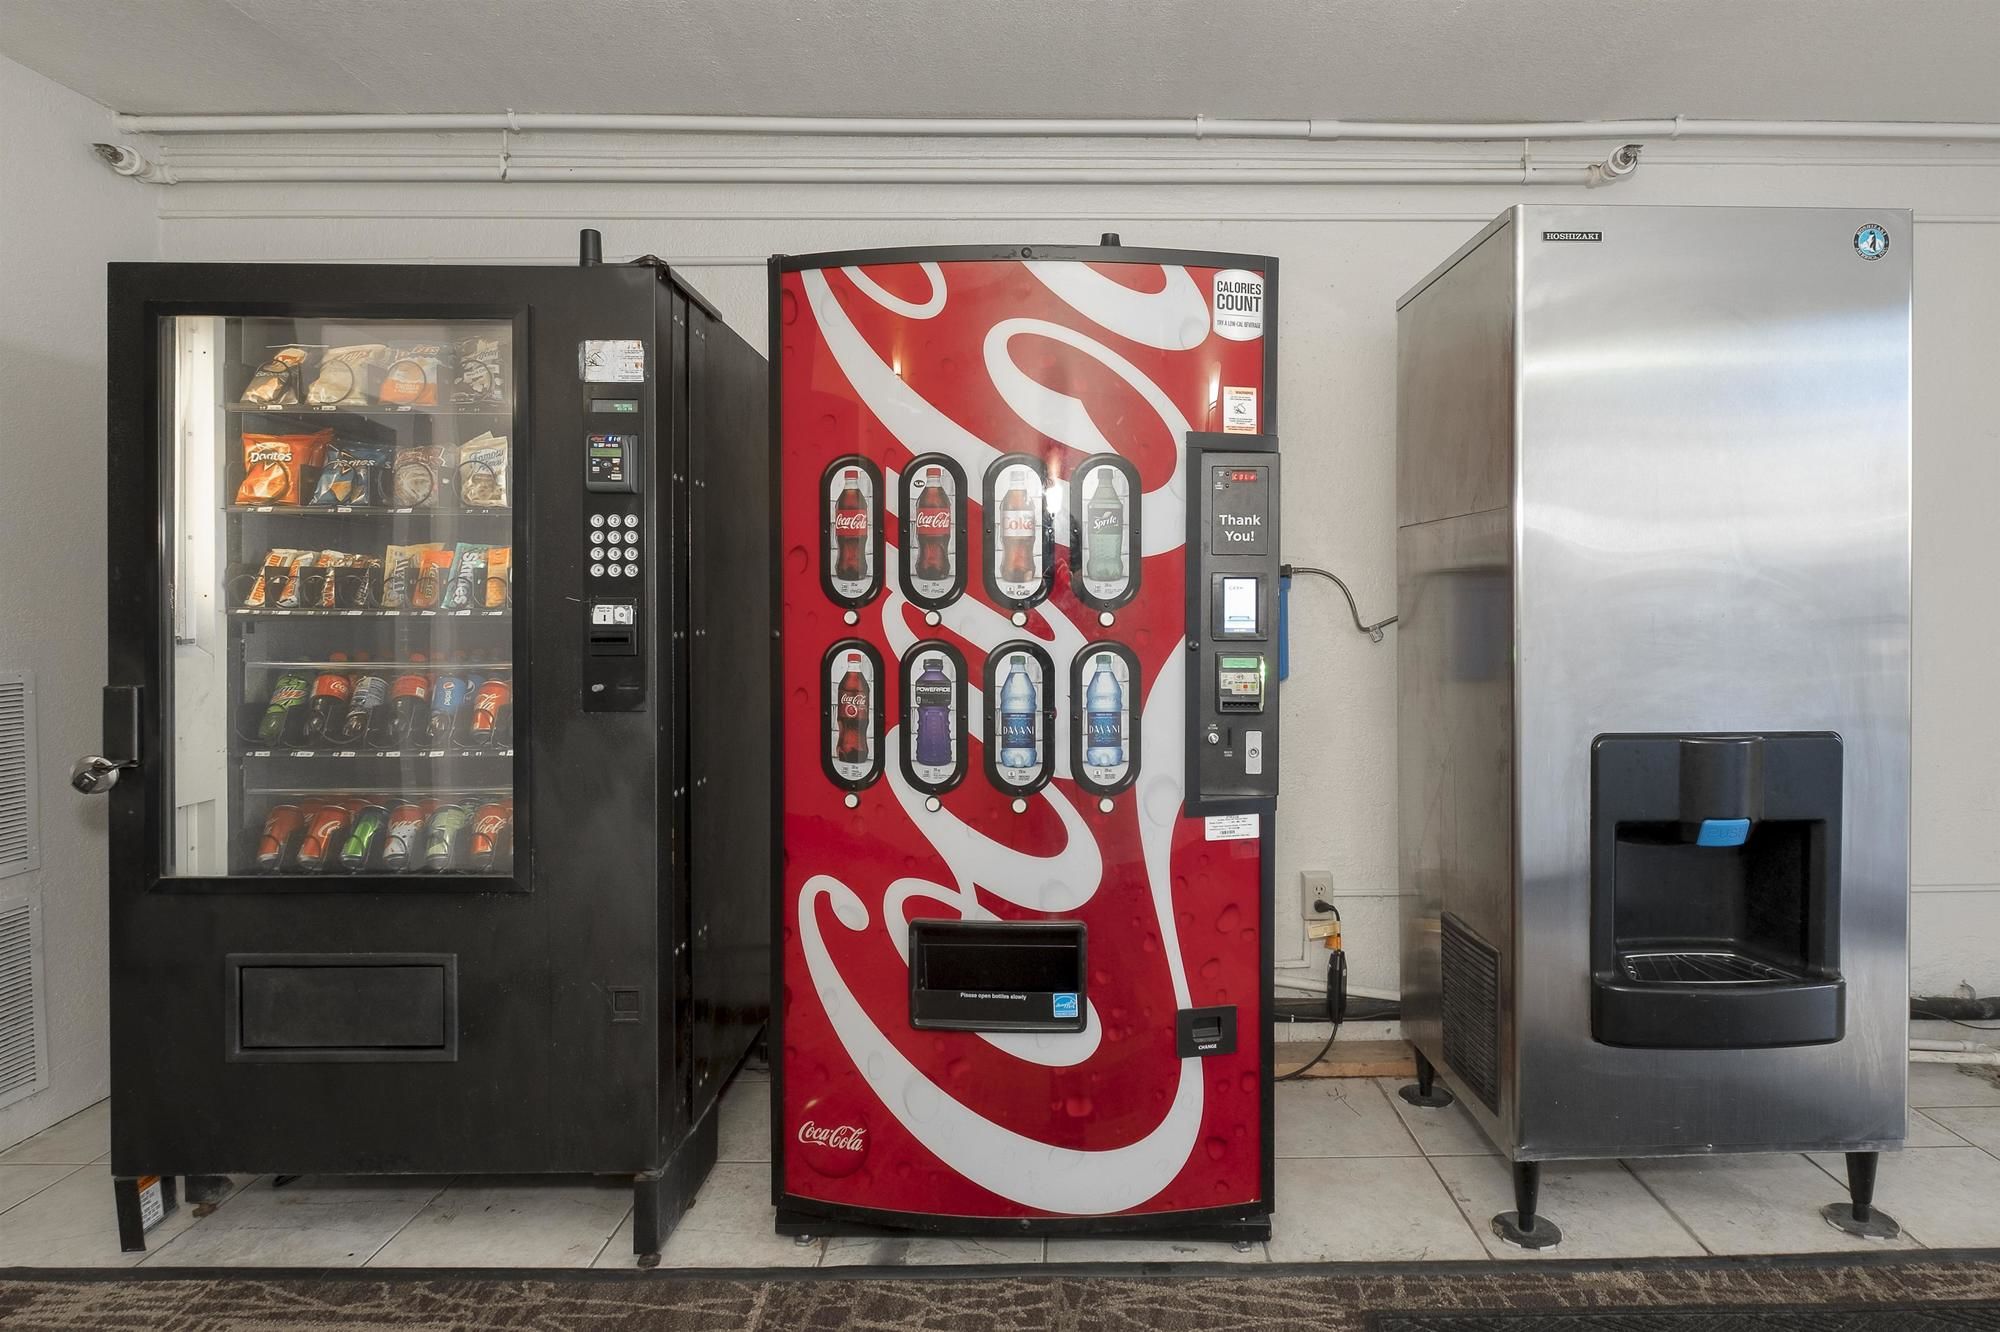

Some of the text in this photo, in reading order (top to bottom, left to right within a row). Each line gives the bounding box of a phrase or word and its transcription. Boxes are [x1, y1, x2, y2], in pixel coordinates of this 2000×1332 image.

[1546, 232, 1599, 240] HOSHIZAKI
[1217, 280, 1262, 296] CALORIES
[1217, 294, 1262, 313] COUNT
[250, 452, 293, 464] Doritos
[835, 513, 867, 530] Coca-Cola
[916, 511, 950, 528] Coca-Cola
[1093, 514, 1117, 530] Sprite
[1219, 514, 1261, 526] Thank
[1224, 530, 1255, 542] You!
[916, 685, 951, 694] POWERADE
[840, 694, 867, 706] Coca-Cola
[1003, 725, 1035, 736] DASANI
[1089, 724, 1120, 735] DASANI
[798, 1120, 867, 1152] Coca-Cola
